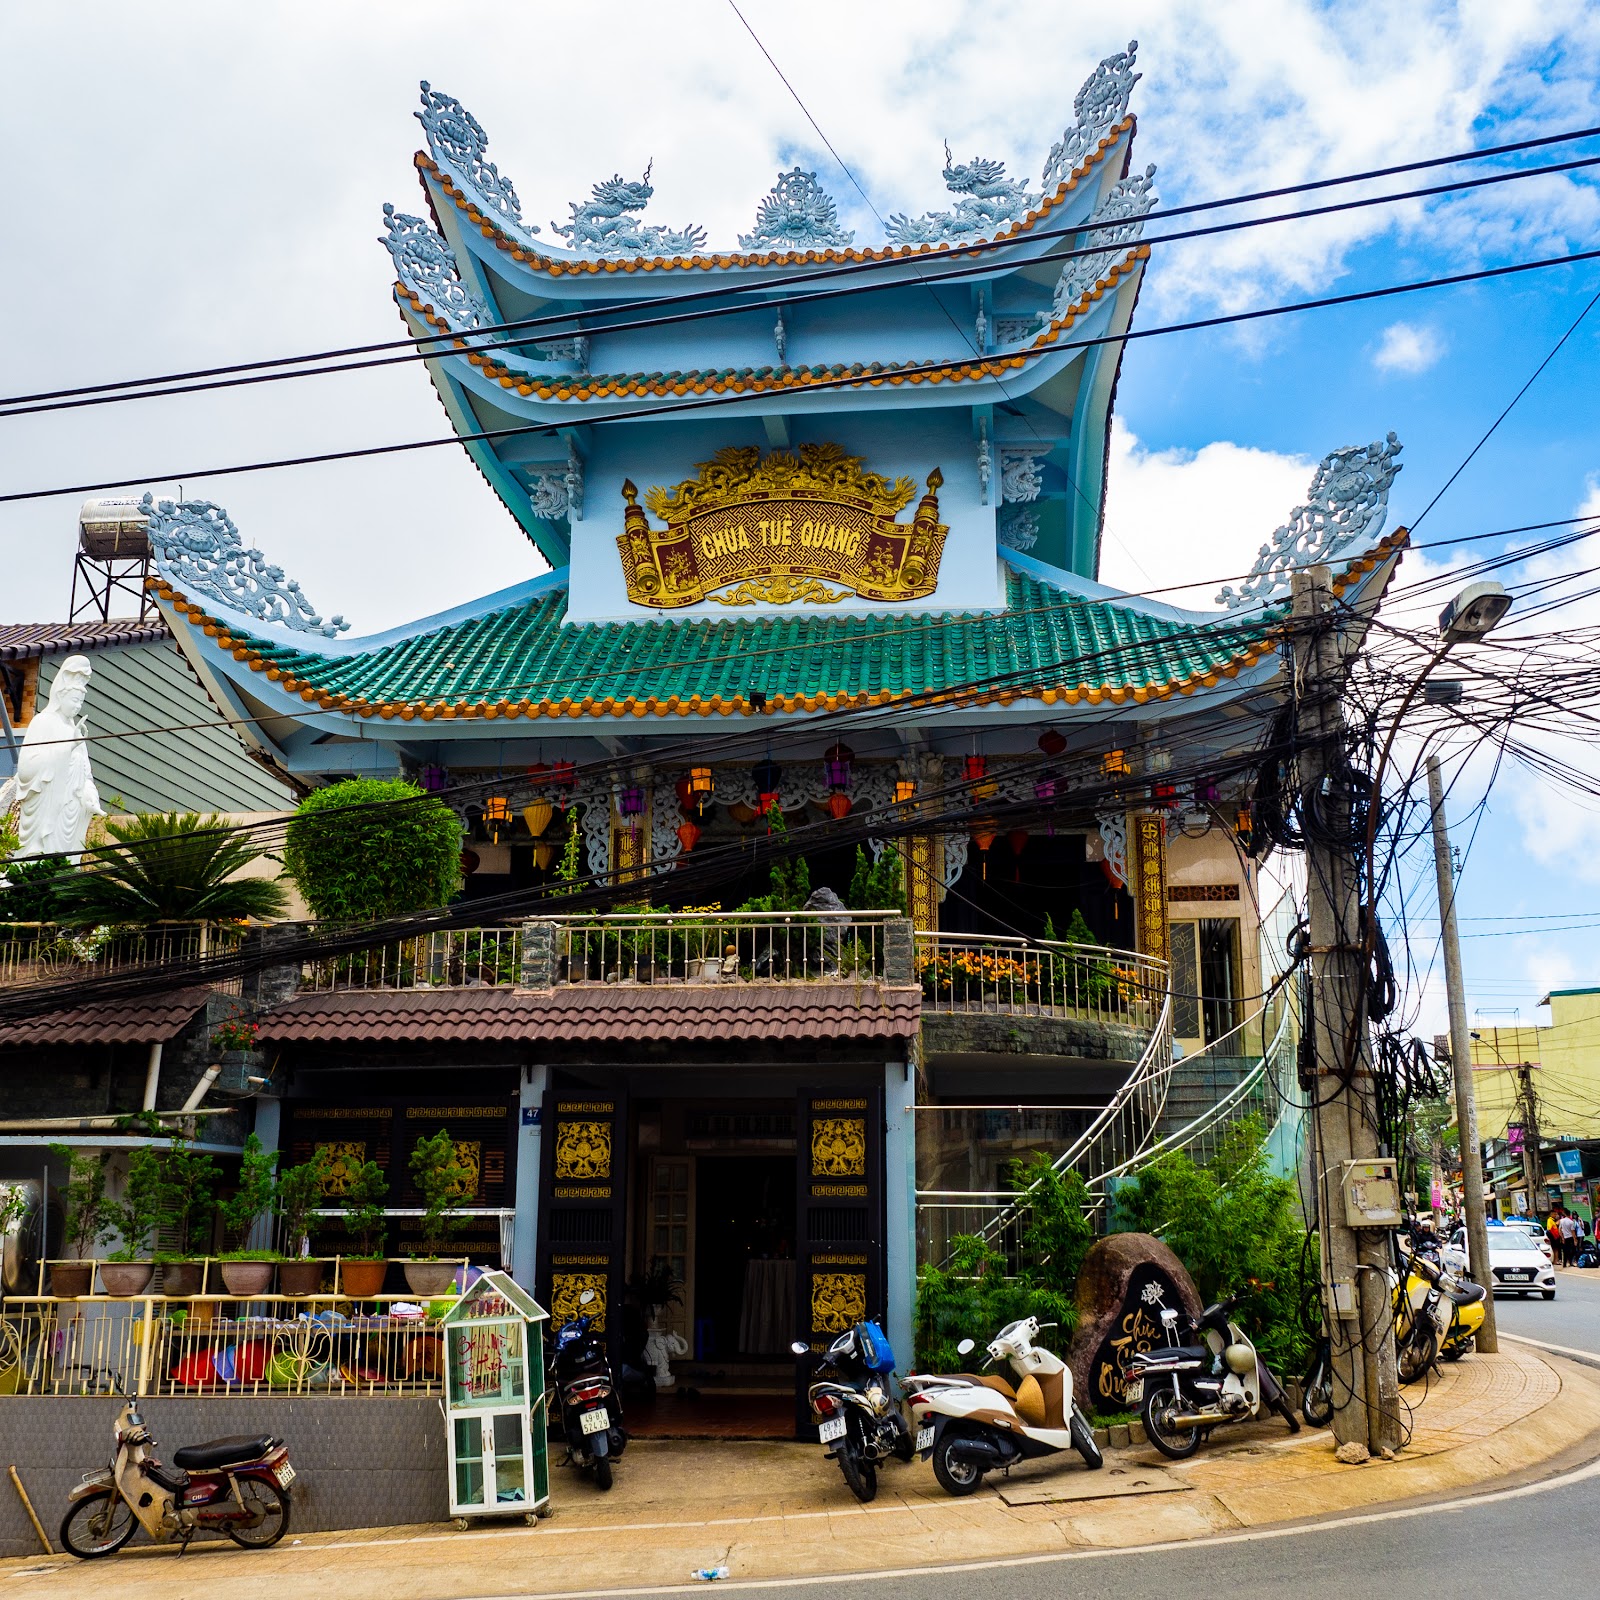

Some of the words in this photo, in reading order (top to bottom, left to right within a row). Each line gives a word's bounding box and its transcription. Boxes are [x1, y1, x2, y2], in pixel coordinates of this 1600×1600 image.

[702, 520, 750, 559] CHÙA
[759, 513, 793, 552] TUỆ
[801, 520, 861, 558] QUANG
[526, 1109, 539, 1118] 47
[1122, 1308, 1161, 1342] Chùa
